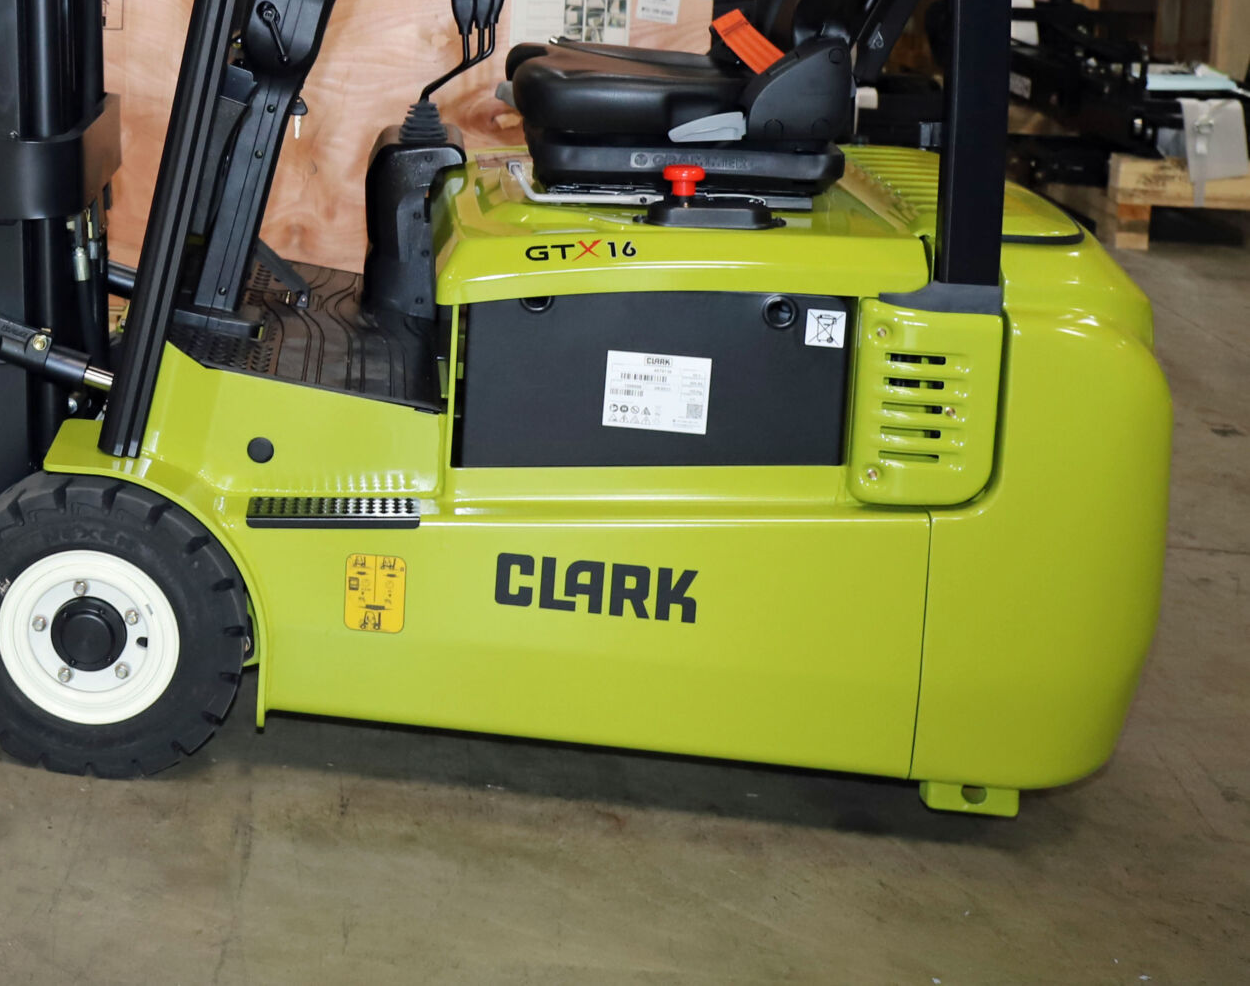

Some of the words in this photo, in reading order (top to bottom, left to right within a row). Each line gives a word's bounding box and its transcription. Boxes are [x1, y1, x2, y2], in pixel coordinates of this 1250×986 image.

[525, 239, 603, 262] GTX
[607, 240, 637, 258] 16
[646, 357, 671, 366] CLARK
[494, 552, 699, 624] CLARK
